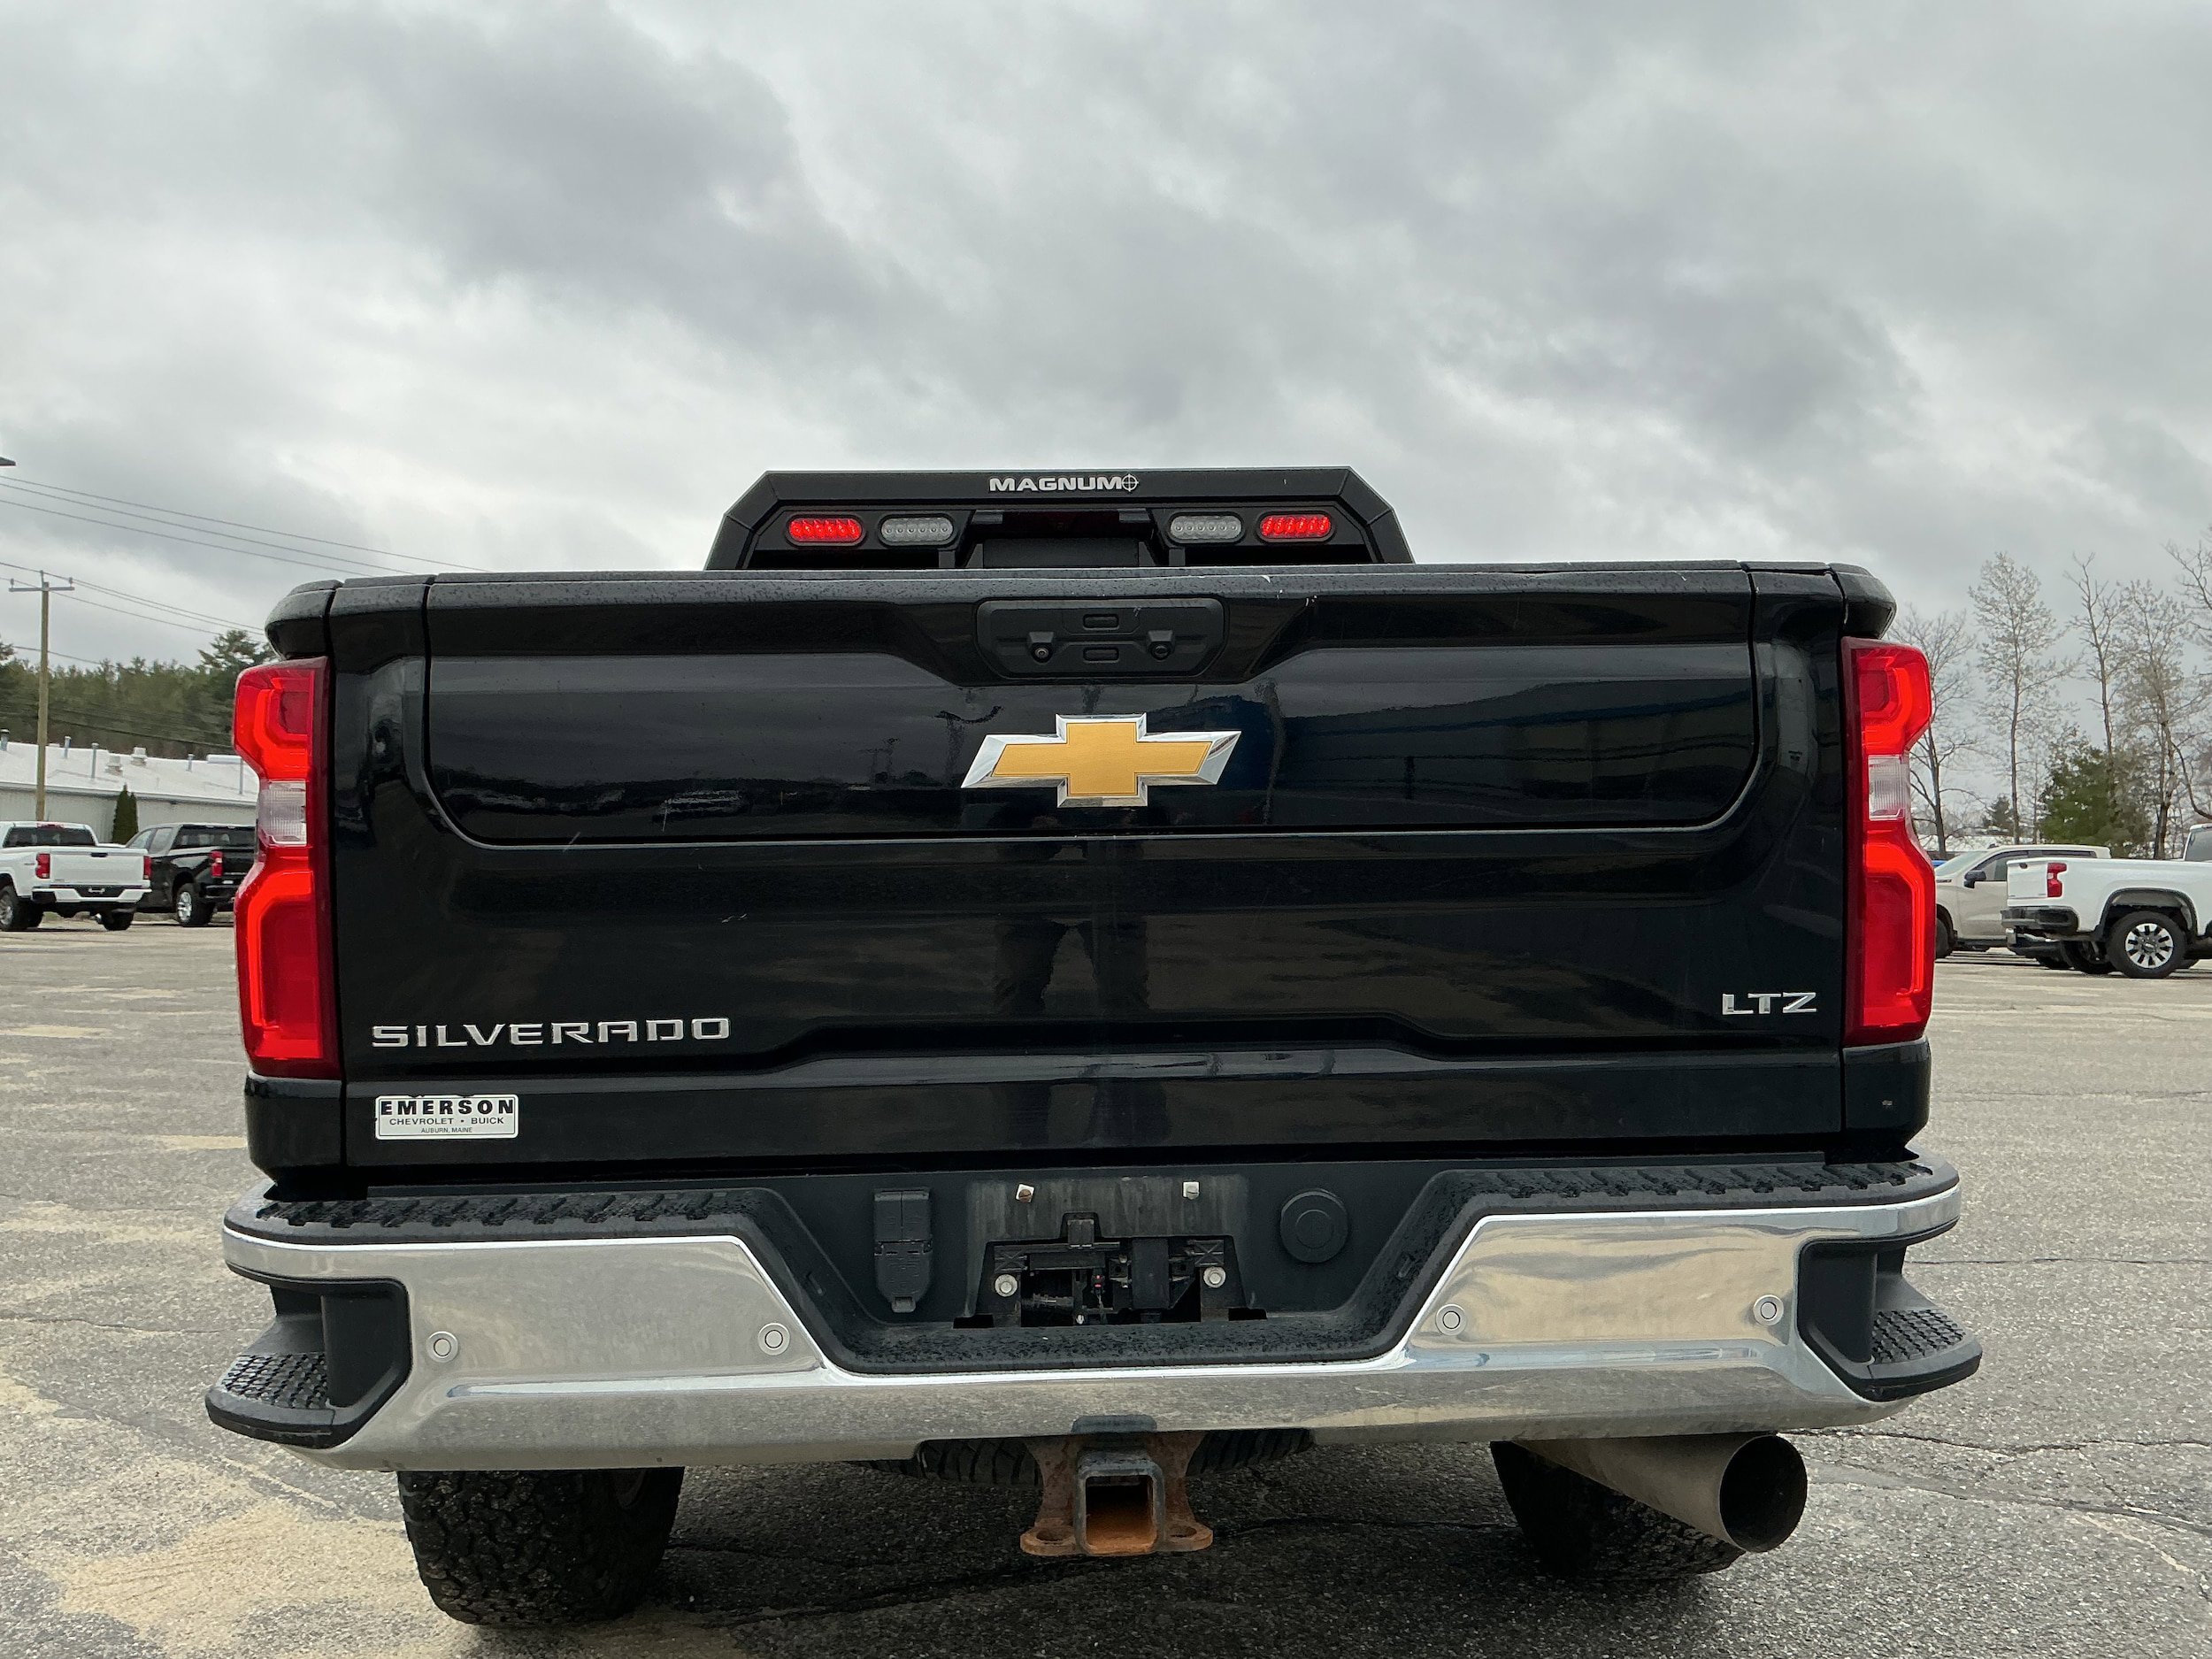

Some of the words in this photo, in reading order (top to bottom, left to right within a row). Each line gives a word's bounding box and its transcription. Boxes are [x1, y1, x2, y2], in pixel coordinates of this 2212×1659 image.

[989, 476, 1122, 492] MAGNUM
[1722, 992, 1817, 1016] LTZ
[372, 1017, 731, 1048] SILVERADO
[380, 1099, 513, 1116] EMERSON
